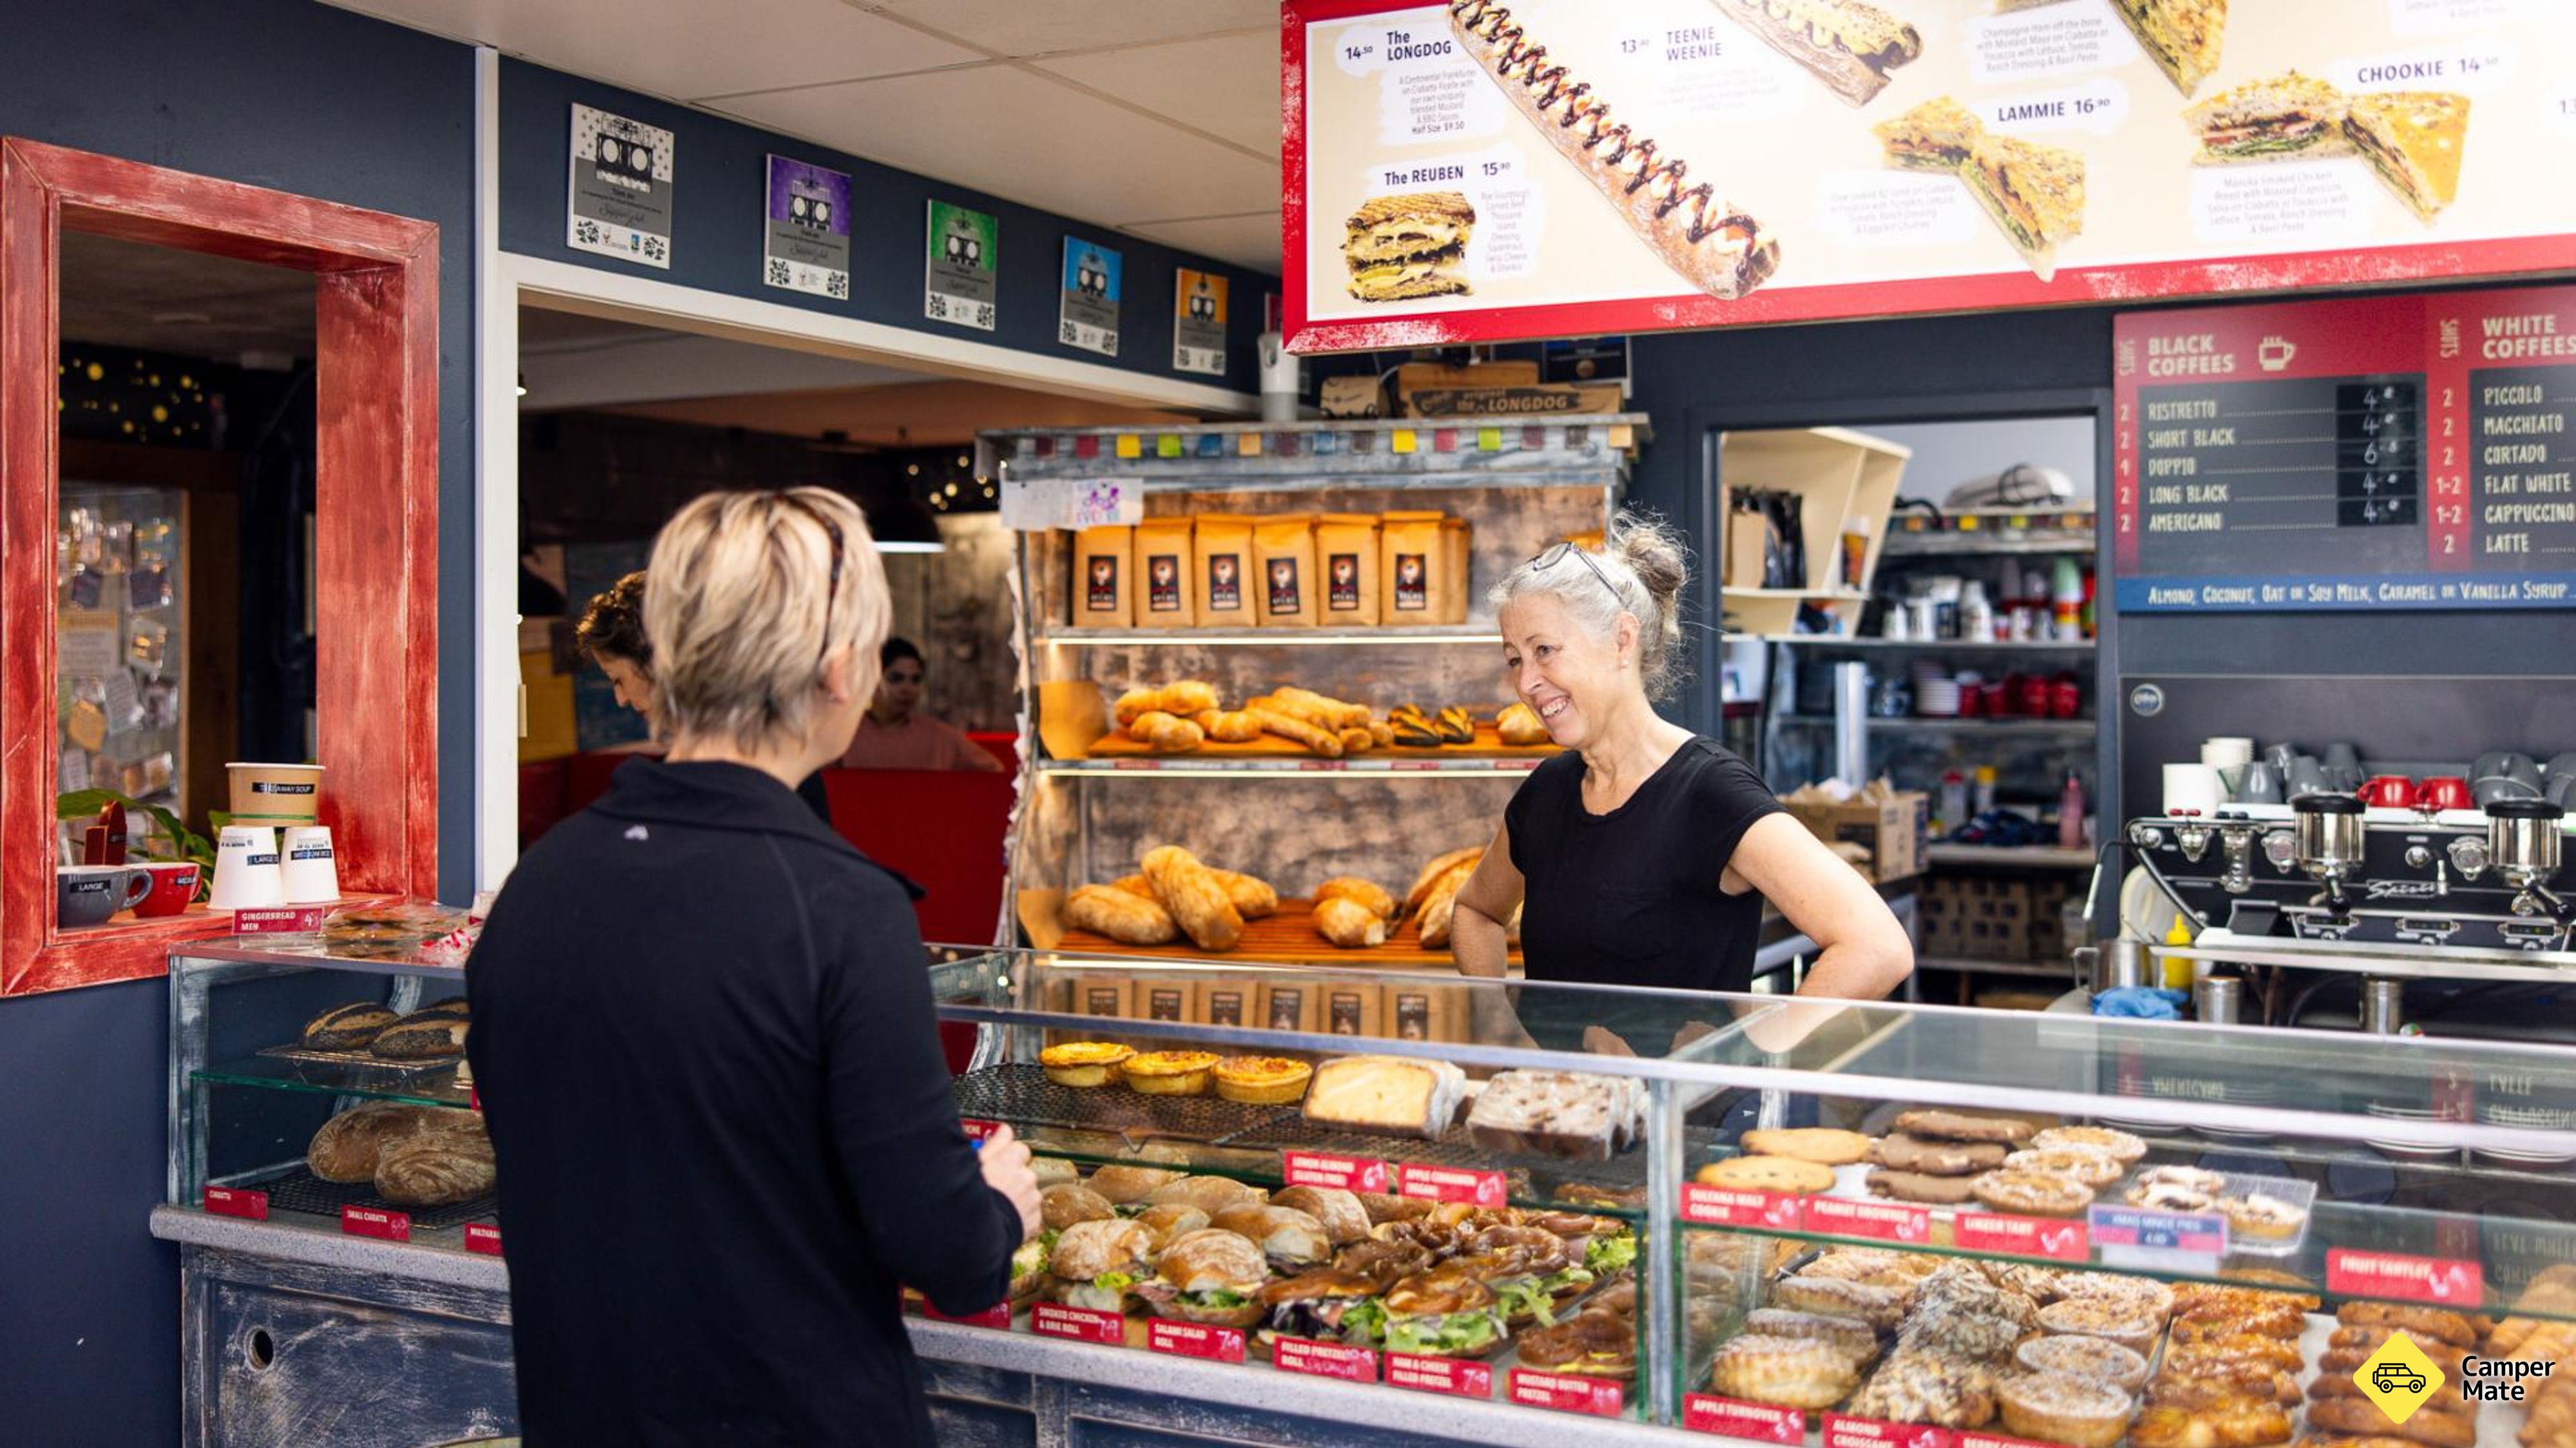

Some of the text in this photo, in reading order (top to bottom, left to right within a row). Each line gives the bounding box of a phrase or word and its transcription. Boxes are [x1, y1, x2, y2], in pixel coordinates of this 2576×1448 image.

[1387, 31, 1410, 45] The
[1667, 26, 1715, 44] TEENIE
[1387, 41, 1452, 61] LONGDOG
[1667, 43, 1722, 61] WEENIE
[2358, 60, 2443, 84] CHOOKIE
[1998, 101, 2065, 122] LAMMIE
[1385, 171, 1408, 186] The
[1412, 166, 1464, 183] REUBEN
[2483, 314, 2555, 337] WHITE
[2148, 334, 2213, 356] BLACK
[2483, 334, 2576, 359] COFFEES
[2148, 353, 2234, 377] COFFEES
[1488, 395, 1567, 412] LONGDOG
[2443, 385, 2543, 408] 2 PICCOLO
[2120, 399, 2216, 422] 2 RISTRETTO
[2443, 413, 2564, 437] 2 MACCHIATO
[2120, 428, 2235, 450] 2 SHORT BLACK
[2443, 444, 2547, 466] 2 CORTADO
[2148, 457, 2196, 477] DOPPIO
[2436, 472, 2571, 495] 1-2 FLAT WHITE
[2121, 484, 2229, 505] 2 LONG BLACK
[2121, 513, 2222, 533] 2 AMERICANO
[2436, 503, 2576, 525] 1-2 CAPPUCCINO
[2444, 533, 2530, 554] 2 LATTE
[79, 882, 104, 891] LARGE
[242, 911, 296, 921] GINGERBREAD
[1813, 1199, 1857, 1216] PEANUT
[1038, 1306, 1067, 1319] SMOKED
[1068, 1311, 1100, 1325] CHICKEN
[1063, 1322, 1081, 1335] ROLL
[1154, 1322, 1182, 1337] SALAMI
[1182, 1327, 1208, 1341] SALAD
[1154, 1335, 1175, 1349] ROLL
[1281, 1341, 1310, 1355] FILLED
[1281, 1354, 1305, 1368] ROLL
[1392, 1356, 1412, 1367] HAM
[1420, 1359, 1450, 1374] CHEESE
[1392, 1369, 1453, 1389] FILLED PRETZEL
[1517, 1373, 1557, 1389] MUSTARD
[1517, 1387, 1551, 1402] PRETZEL
[1692, 1398, 1783, 1424] APPLE TURNOVER
[1833, 1419, 1882, 1436] ALMOND
